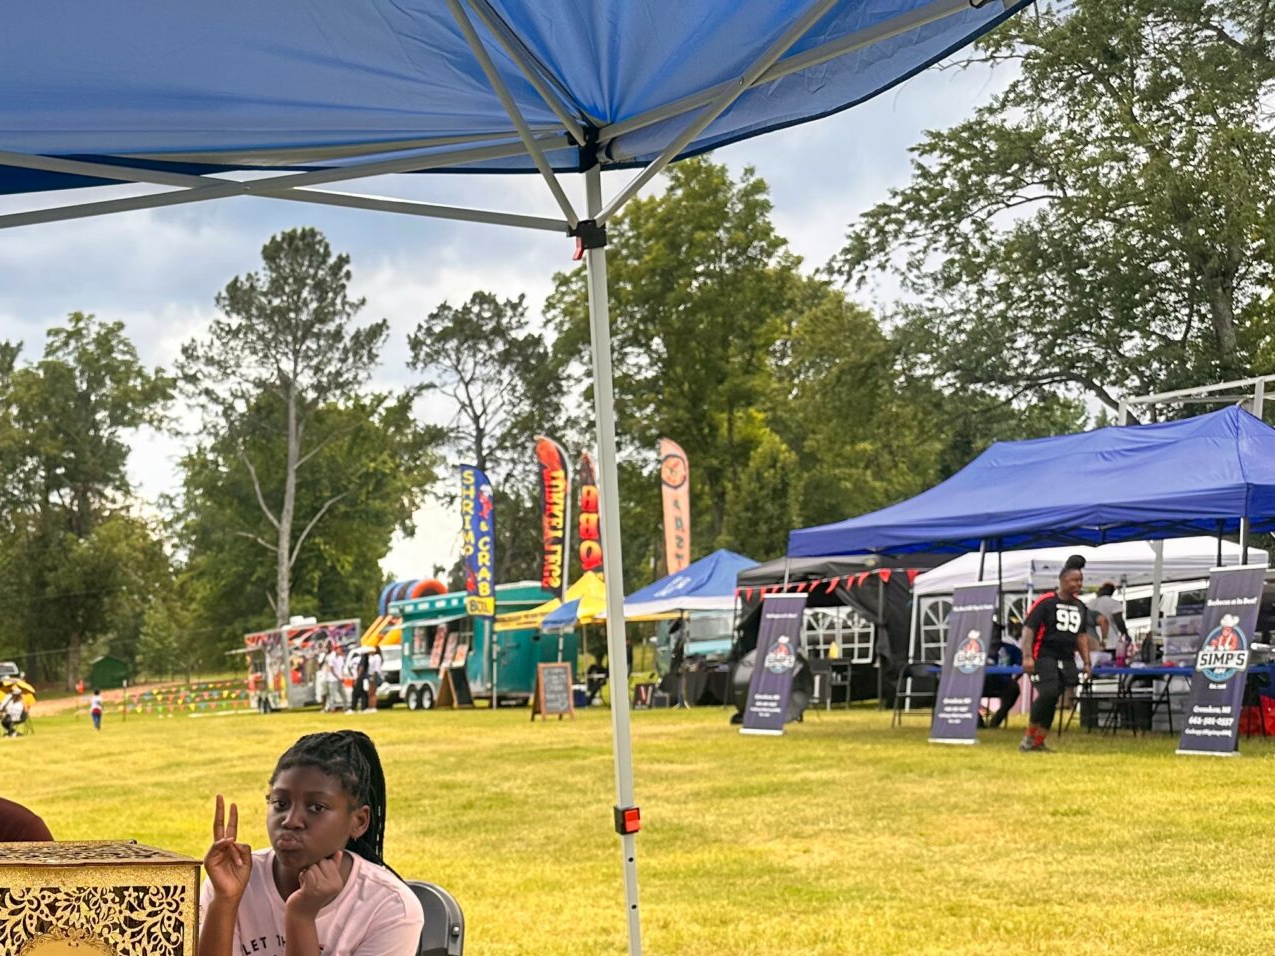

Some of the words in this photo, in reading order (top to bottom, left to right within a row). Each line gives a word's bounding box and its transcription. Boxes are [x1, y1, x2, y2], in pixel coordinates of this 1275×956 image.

[579, 485, 603, 571] BBQ
[477, 536, 491, 597] CRAB
[1056, 609, 1081, 633] 99
[1200, 653, 1246, 666] SIMP'S
[242, 936, 267, 956] LET
